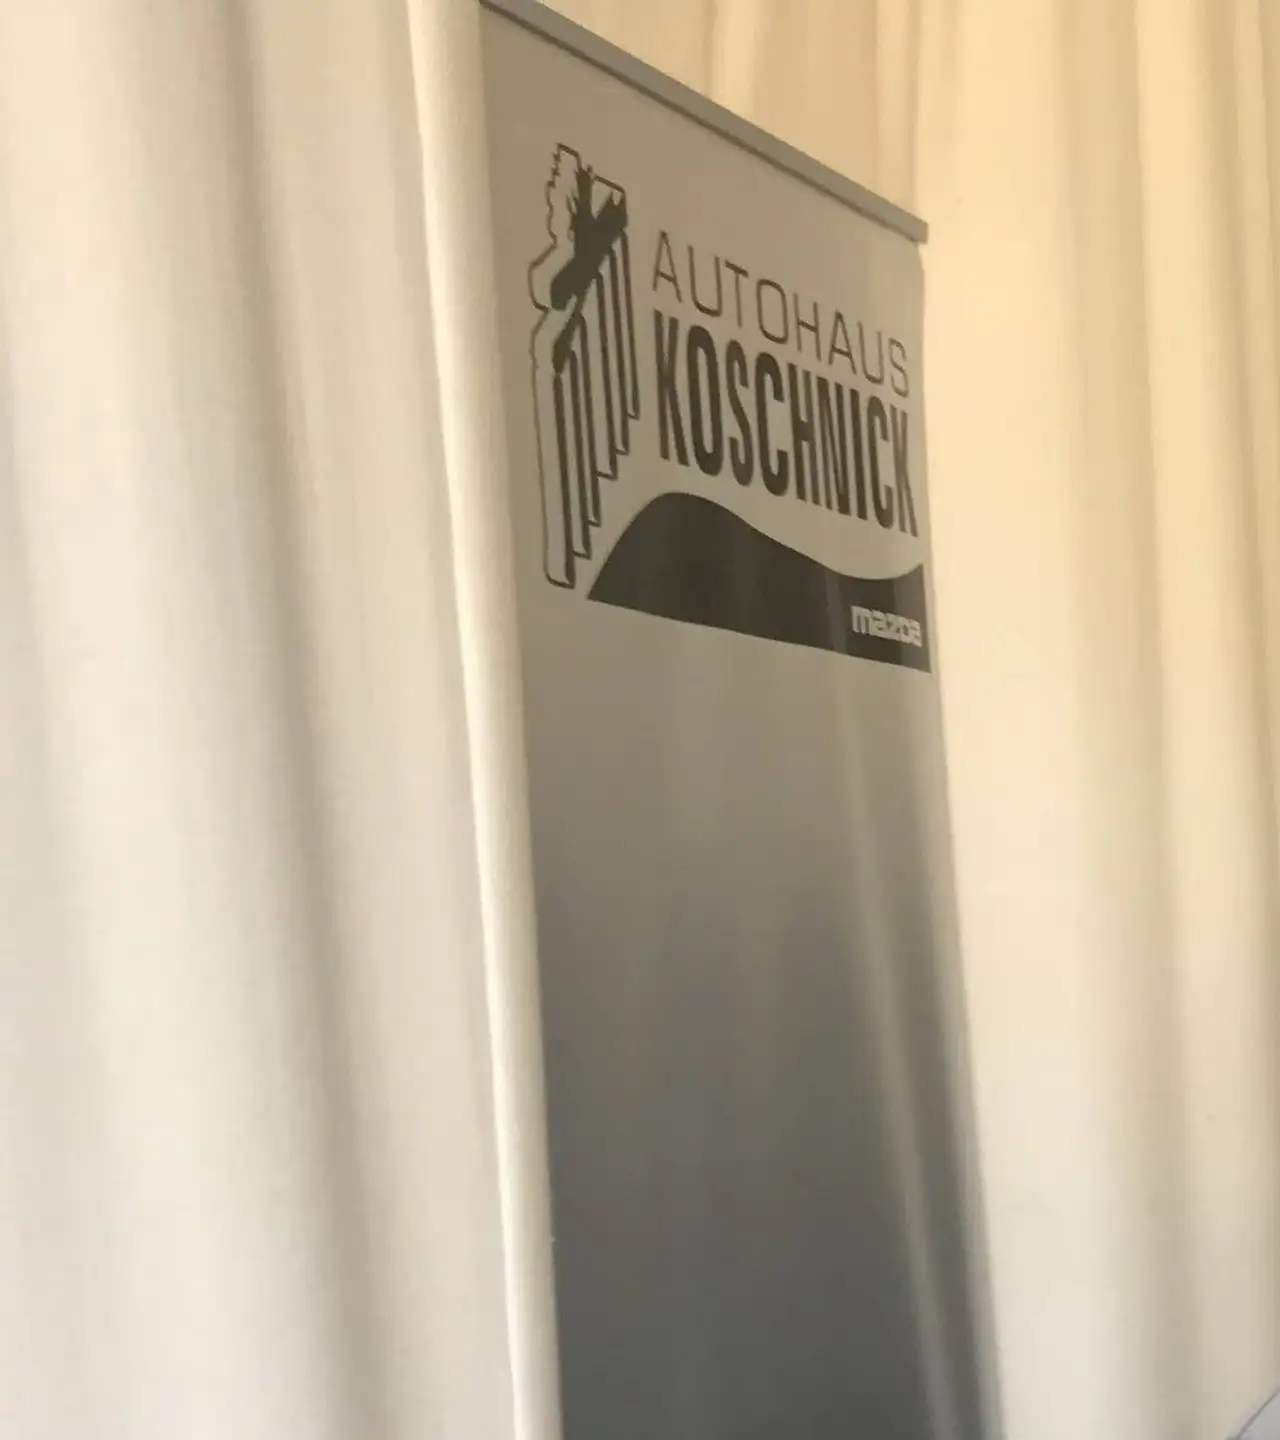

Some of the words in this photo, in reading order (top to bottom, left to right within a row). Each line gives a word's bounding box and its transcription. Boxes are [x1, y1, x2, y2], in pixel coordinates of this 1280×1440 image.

[651, 230, 910, 398] AUTOHAUS
[652, 309, 919, 538] KOSCHNICK
[850, 605, 923, 648] mazda
